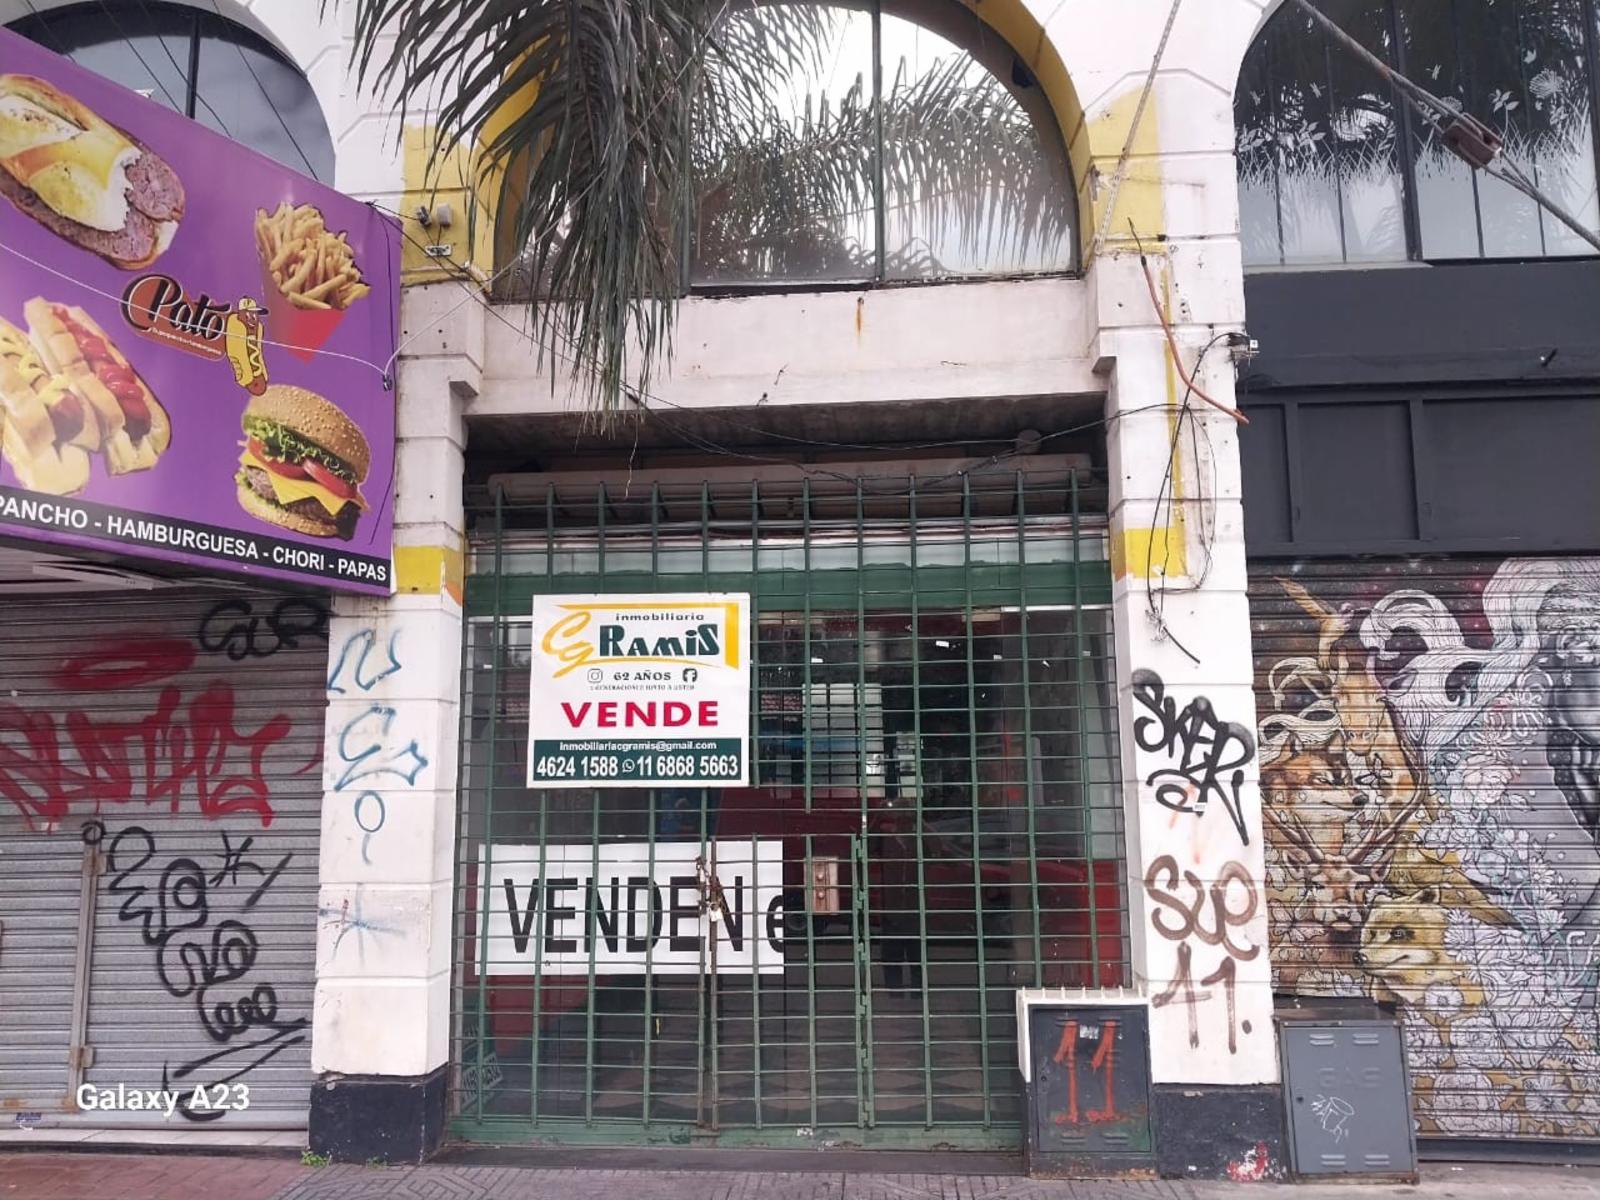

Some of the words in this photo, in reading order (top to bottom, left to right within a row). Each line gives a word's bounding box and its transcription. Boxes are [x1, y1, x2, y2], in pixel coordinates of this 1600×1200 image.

[121, 274, 231, 341] Pato
[0, 495, 88, 528] ANCHO
[107, 515, 259, 560] HAMBURGUESA
[273, 546, 325, 571] CHORI
[338, 558, 387, 581] PAPAS
[616, 613, 704, 621] inmobiliaria
[613, 671, 630, 681] 62
[634, 669, 672, 681] AÑOS
[561, 701, 719, 728] VENDE
[537, 756, 576, 777] 4624
[580, 755, 618, 777] 1588
[637, 756, 653, 776] 11
[656, 755, 695, 776] 6868
[699, 754, 739, 776] 5663
[503, 876, 743, 953] VENDEN
